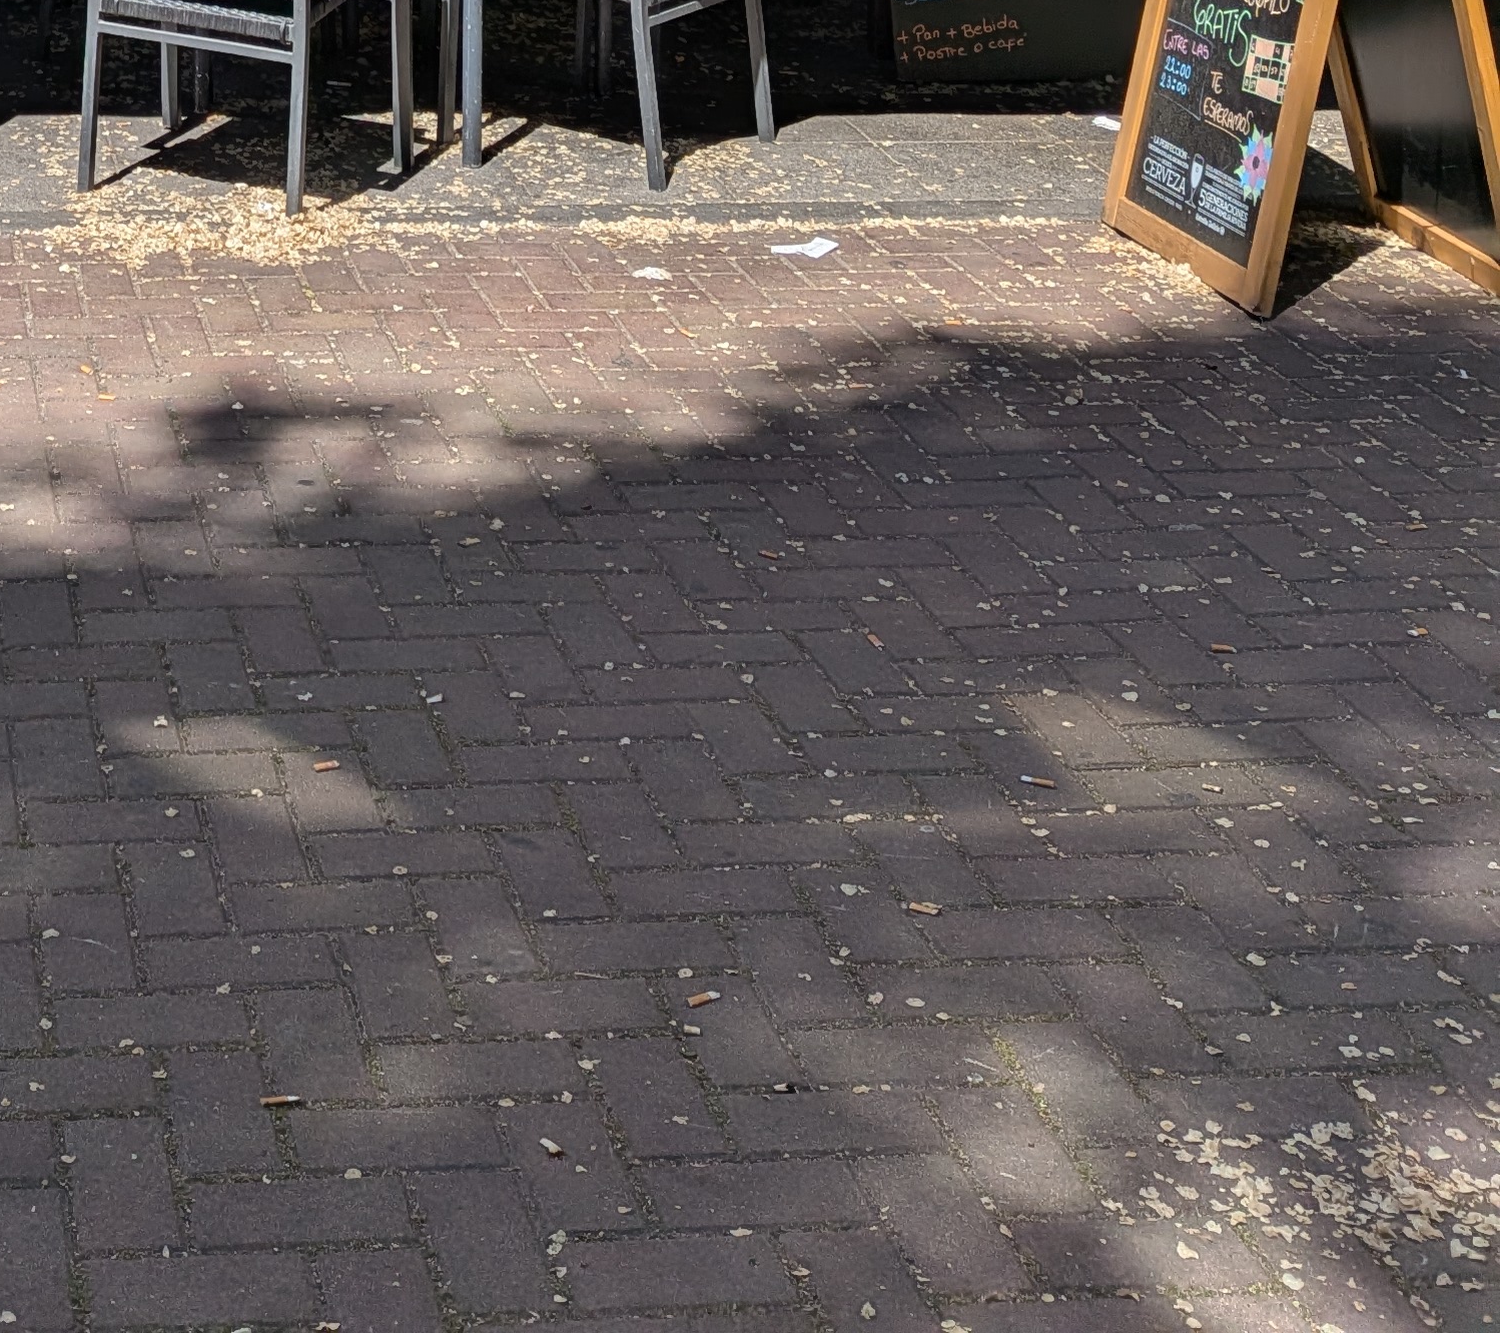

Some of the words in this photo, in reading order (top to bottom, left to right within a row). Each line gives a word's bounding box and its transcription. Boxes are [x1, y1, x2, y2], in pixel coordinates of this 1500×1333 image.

[912, 23, 940, 43] Pan
[961, 13, 1020, 38] Bebida
[1163, 29, 1188, 55] ENTRE
[1191, 41, 1209, 60] LAS
[1210, 71, 1224, 94] TE
[1203, 97, 1254, 136] ESPERAMOS
[1143, 156, 1186, 196] CERVEZA
